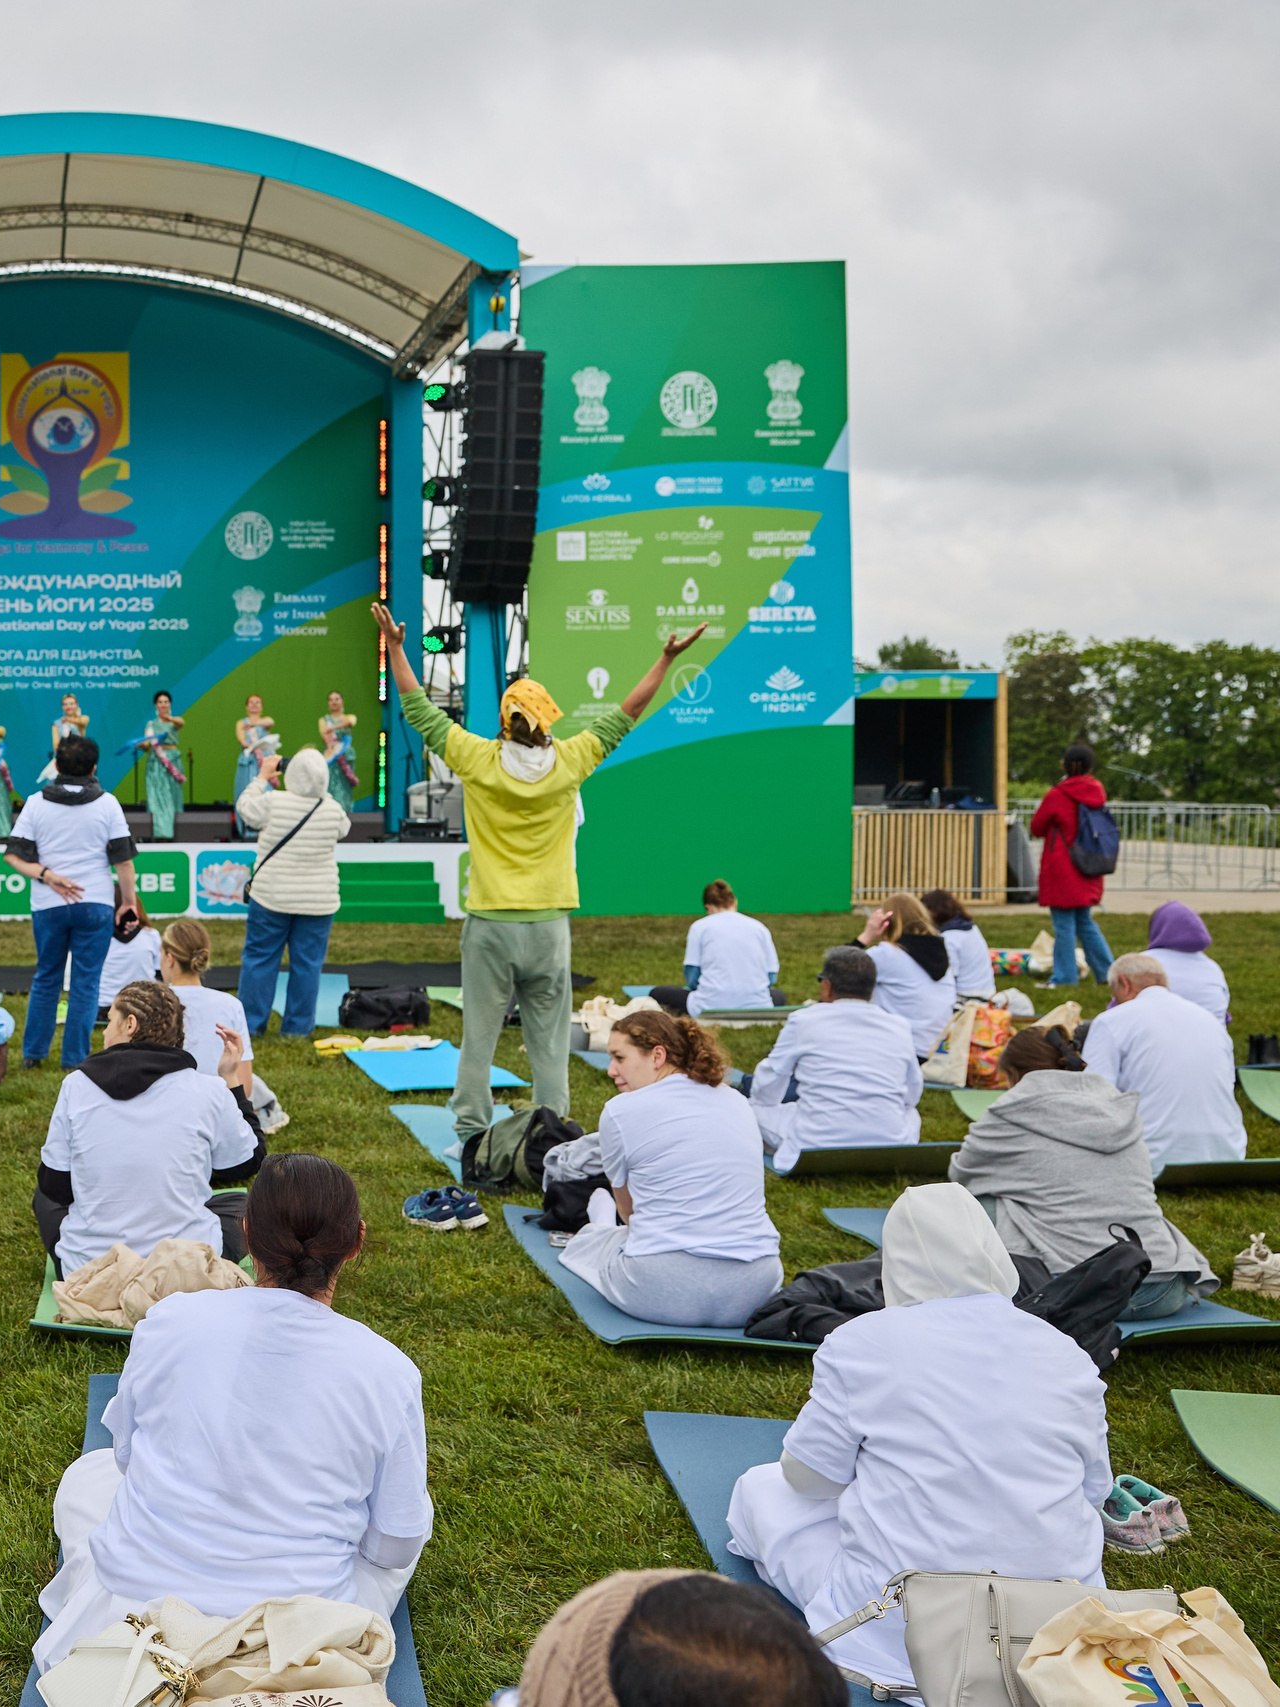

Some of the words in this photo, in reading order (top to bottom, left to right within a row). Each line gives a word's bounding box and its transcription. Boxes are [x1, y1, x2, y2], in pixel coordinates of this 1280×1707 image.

[771, 477, 815, 487] SATTVA
[14, 542, 32, 554] for
[110, 540, 148, 552] Peace
[37, 594, 95, 613] ЙОГИ
[99, 597, 155, 612] 2025
[656, 605, 725, 616] DARBARS
[748, 606, 817, 623] SHREYA
[565, 610, 631, 624] SENTISS
[56, 619, 84, 633] Day
[89, 618, 106, 631] of
[108, 619, 145, 633] Yoga
[148, 618, 189, 630] 2025
[26, 649, 59, 662] ДЛЯ
[61, 649, 143, 662] ЕДИНСТВА
[79, 665, 159, 677] ЗДОРОВЬЯ
[15, 681, 29, 689] for
[32, 681, 52, 689] One
[107, 681, 141, 689] Health
[749, 692, 817, 703] ORGANIC
[763, 702, 805, 713] INDIA
